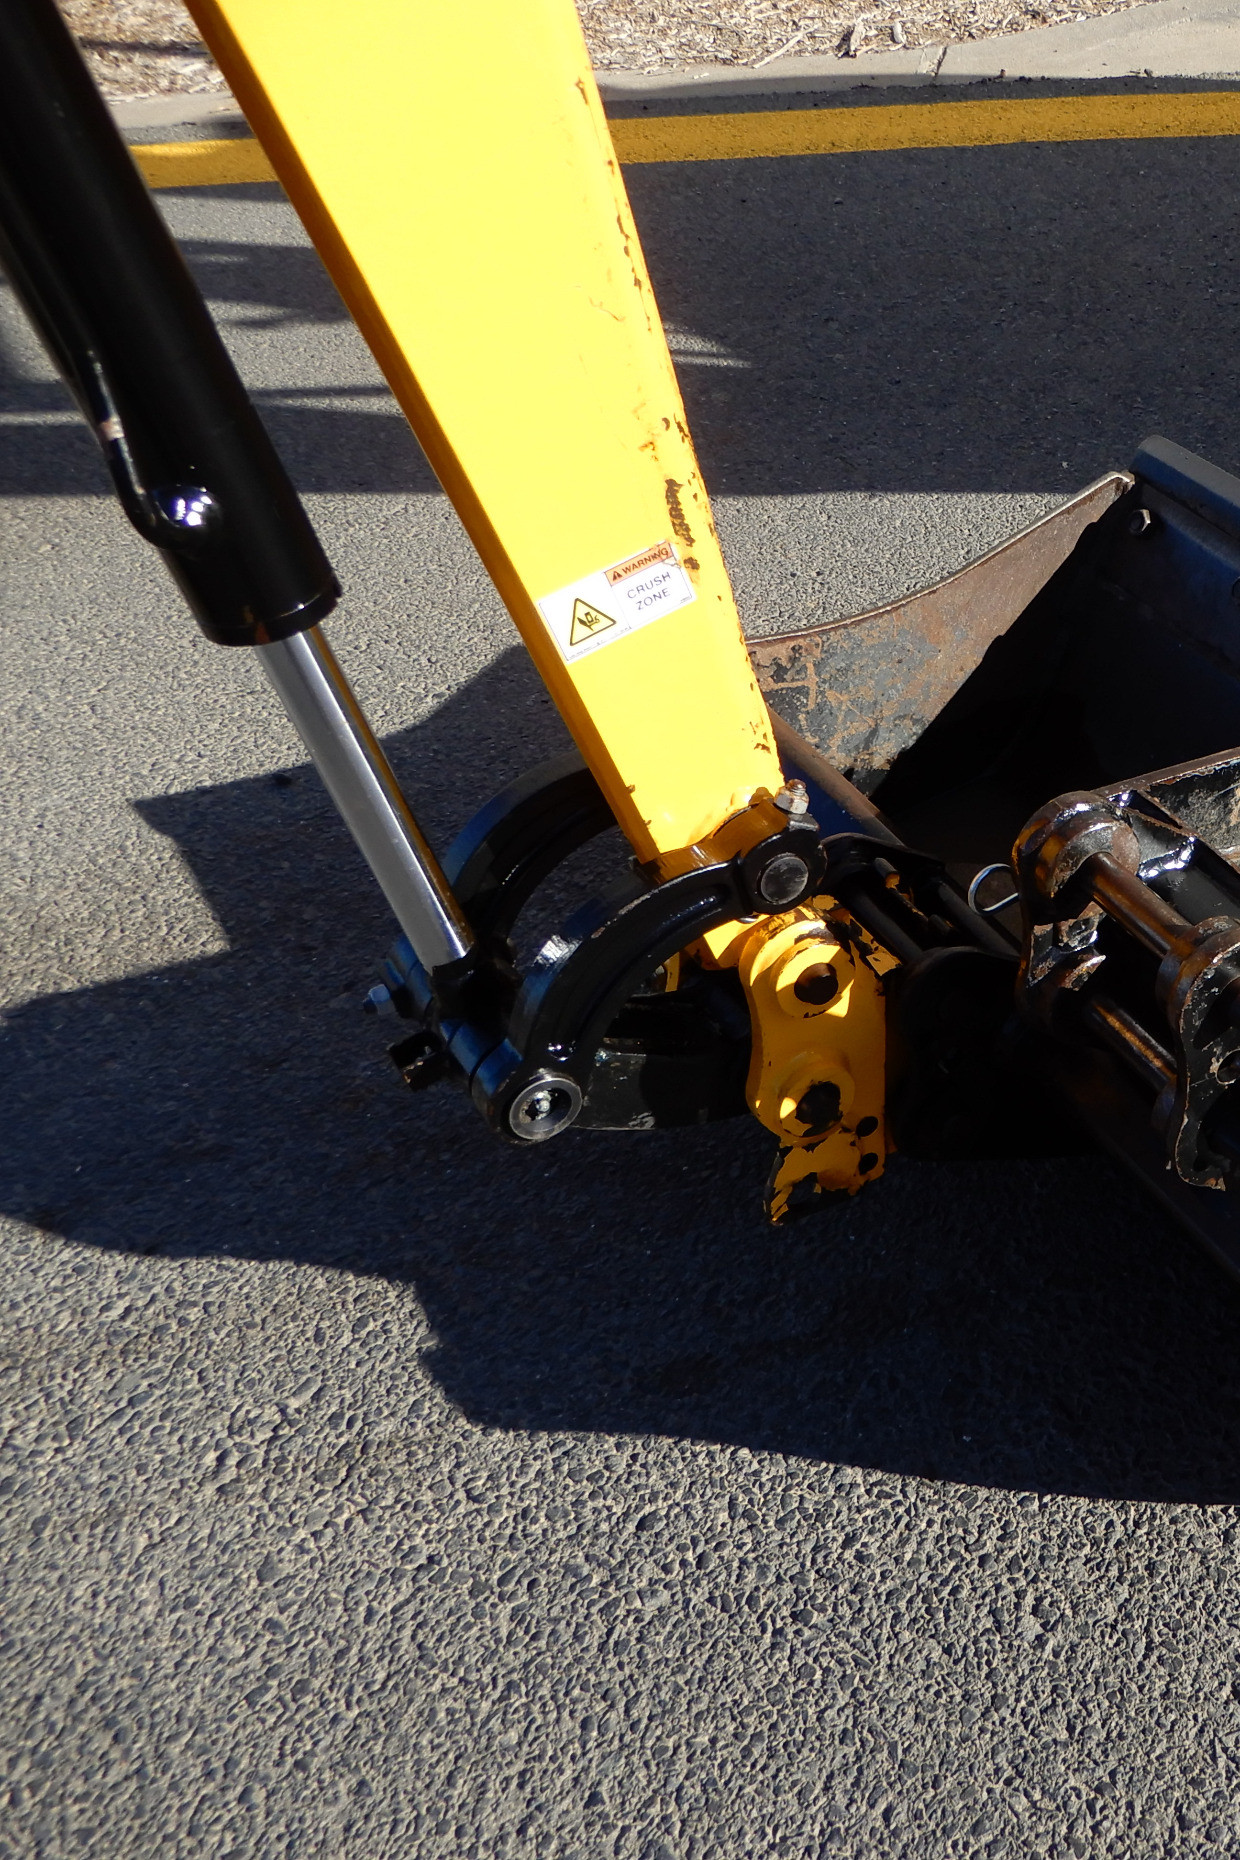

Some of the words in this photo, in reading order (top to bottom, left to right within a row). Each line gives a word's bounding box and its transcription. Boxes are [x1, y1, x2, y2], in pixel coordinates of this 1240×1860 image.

[622, 547, 669, 575] WARNING
[627, 571, 671, 599] CRUSH
[635, 587, 671, 610] ZONE
